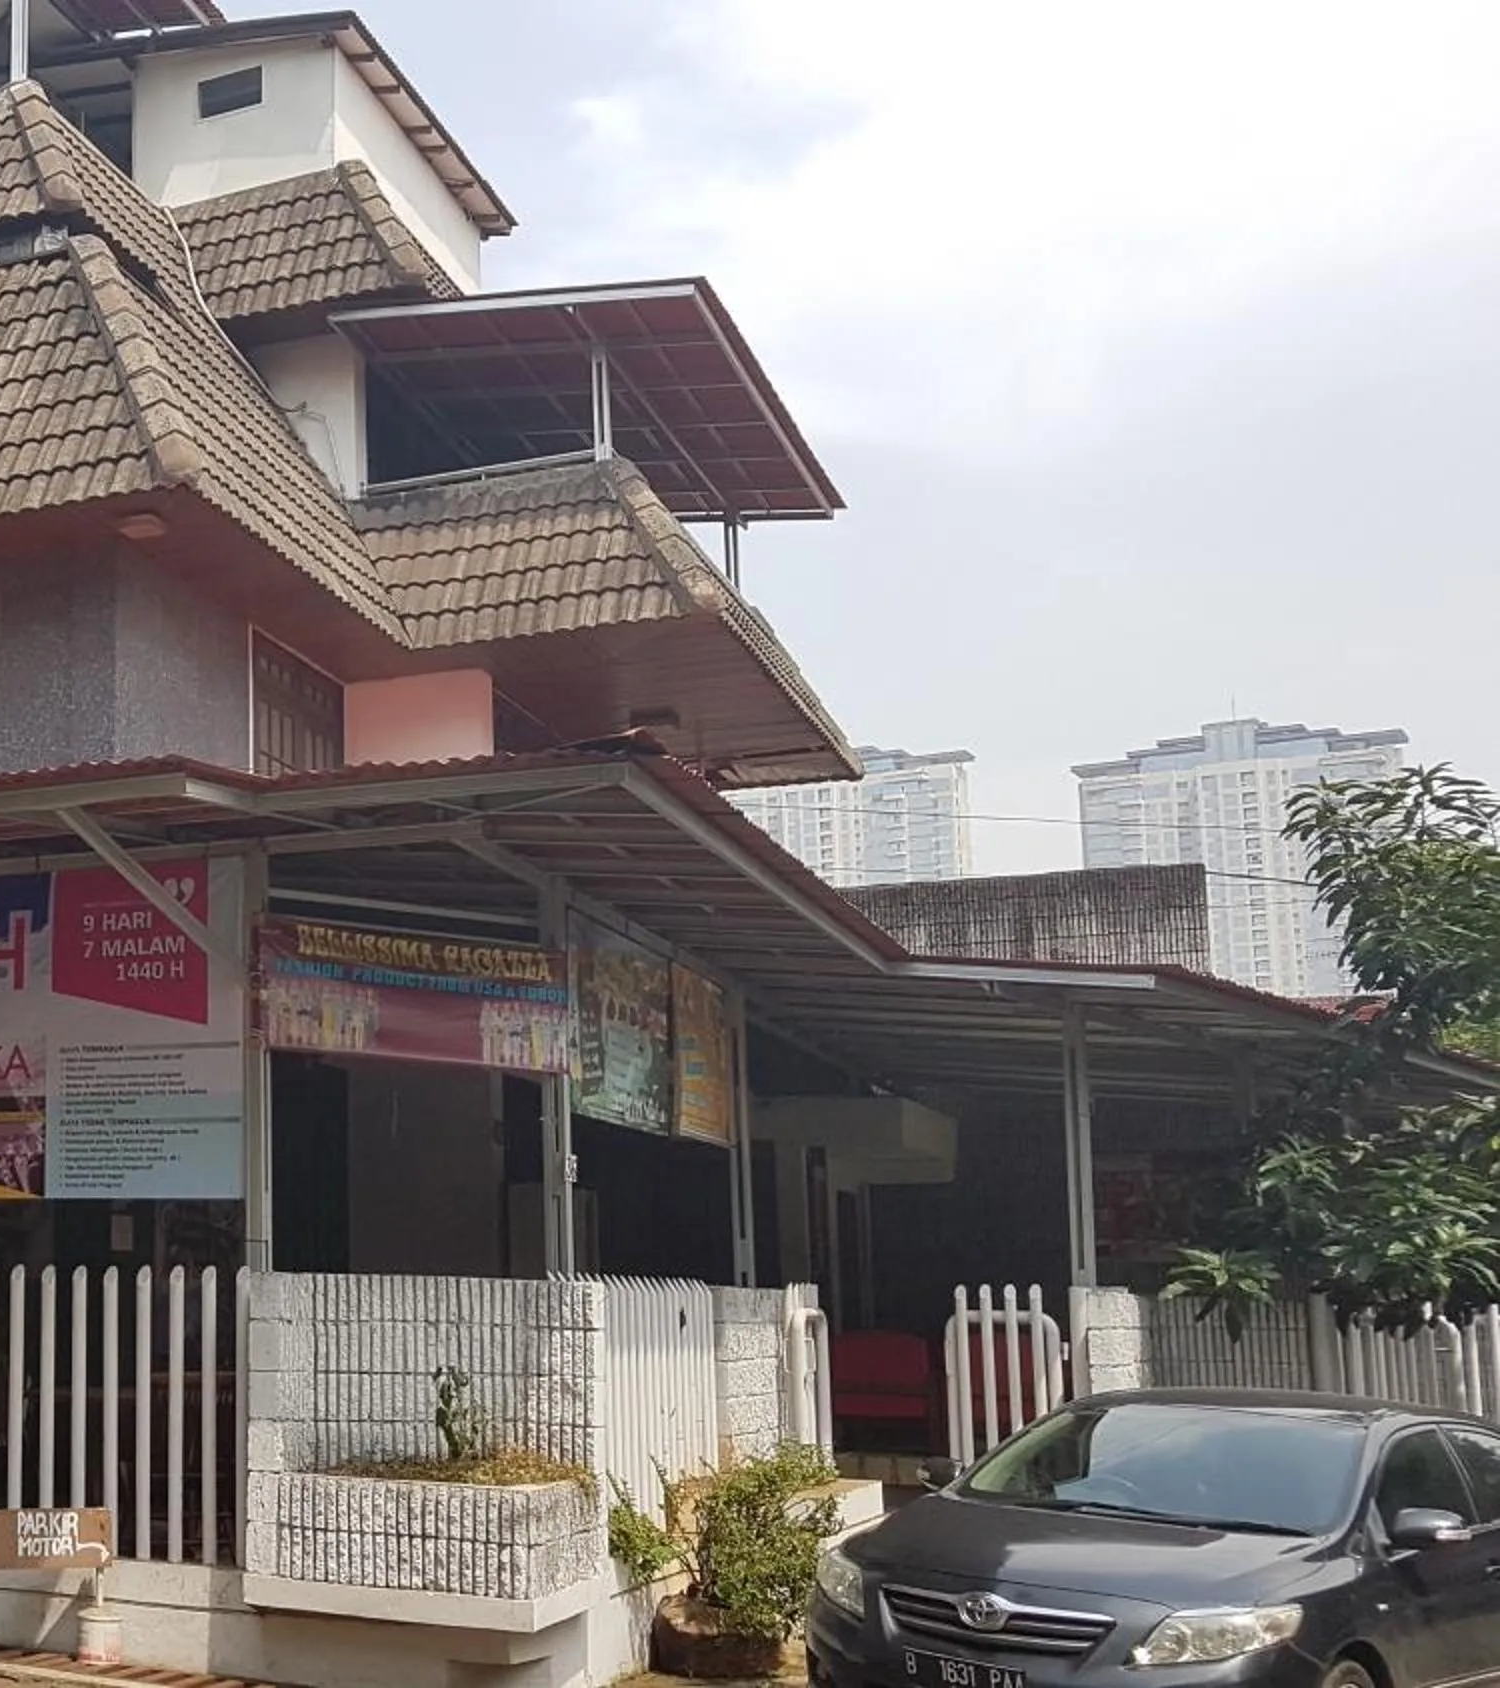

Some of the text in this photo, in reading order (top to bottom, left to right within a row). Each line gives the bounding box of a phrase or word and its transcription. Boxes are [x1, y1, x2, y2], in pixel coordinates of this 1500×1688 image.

[83, 912, 151, 932] 9 HARI
[83, 936, 185, 958] 7 MALAM
[116, 960, 184, 981] 1440 H
[274, 957, 344, 979] FASHION
[353, 966, 424, 988] PRODUCT
[475, 981, 502, 996] USA
[17, 1512, 78, 1536] PARKIR
[17, 1536, 74, 1557] MOTOR
[905, 1652, 917, 1674] B
[940, 1660, 976, 1687] 1631
